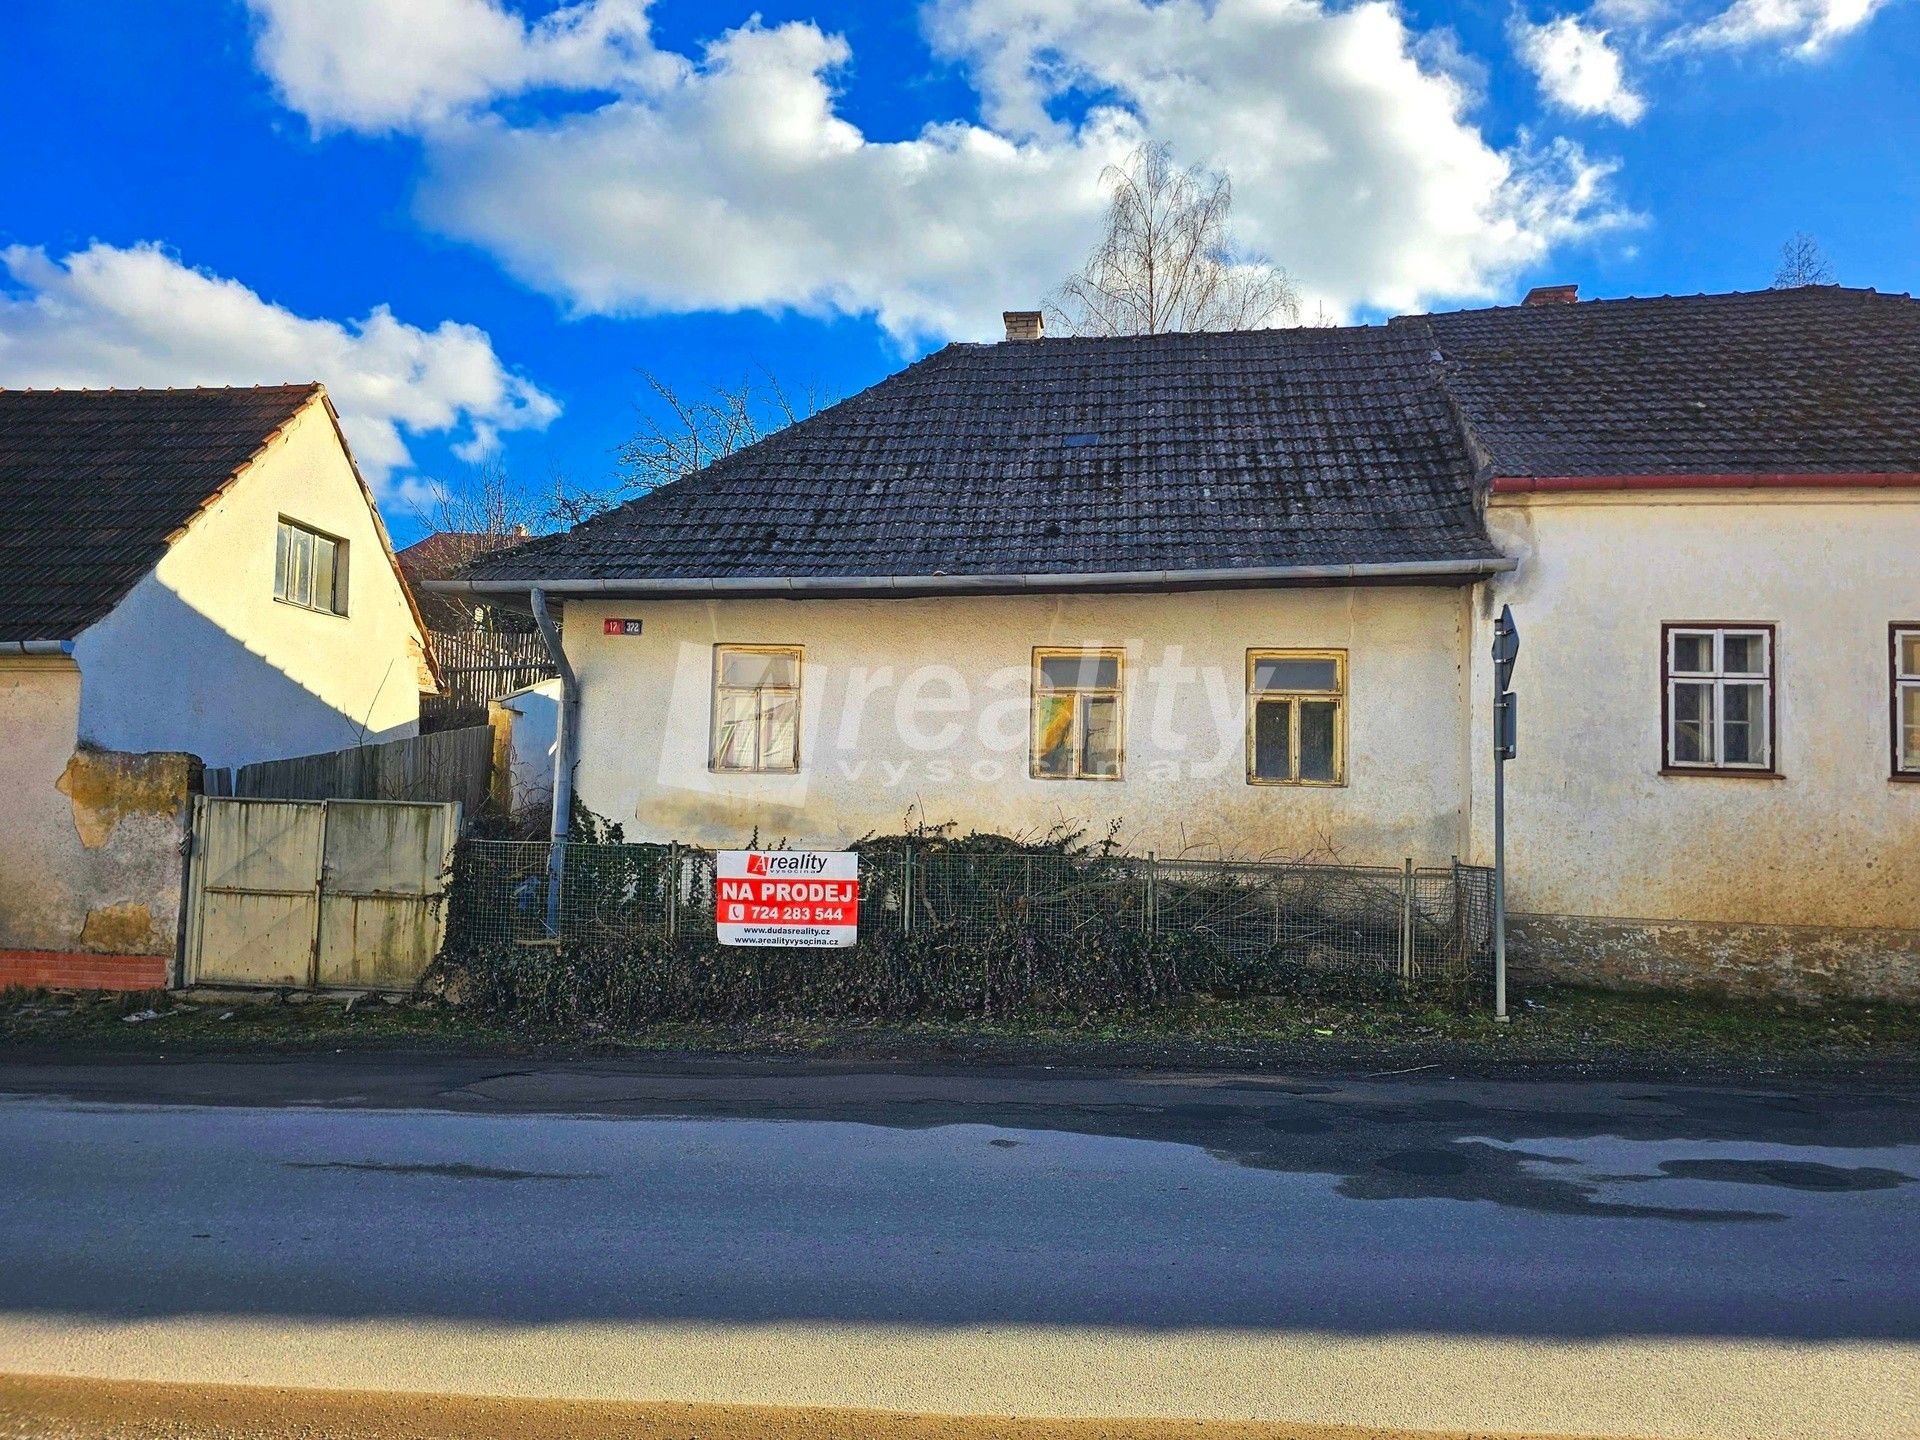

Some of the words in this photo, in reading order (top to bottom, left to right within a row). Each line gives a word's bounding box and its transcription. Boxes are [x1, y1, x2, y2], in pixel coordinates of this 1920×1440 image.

[721, 882, 754, 901] NA
[761, 883, 853, 902] PRODEJ
[751, 906, 779, 920] 724
[783, 906, 810, 920] 283
[815, 907, 843, 920] 544
[743, 927, 831, 937] www.dudasreality.cz
[734, 936, 839, 946] www.arealityvysocina.cz
